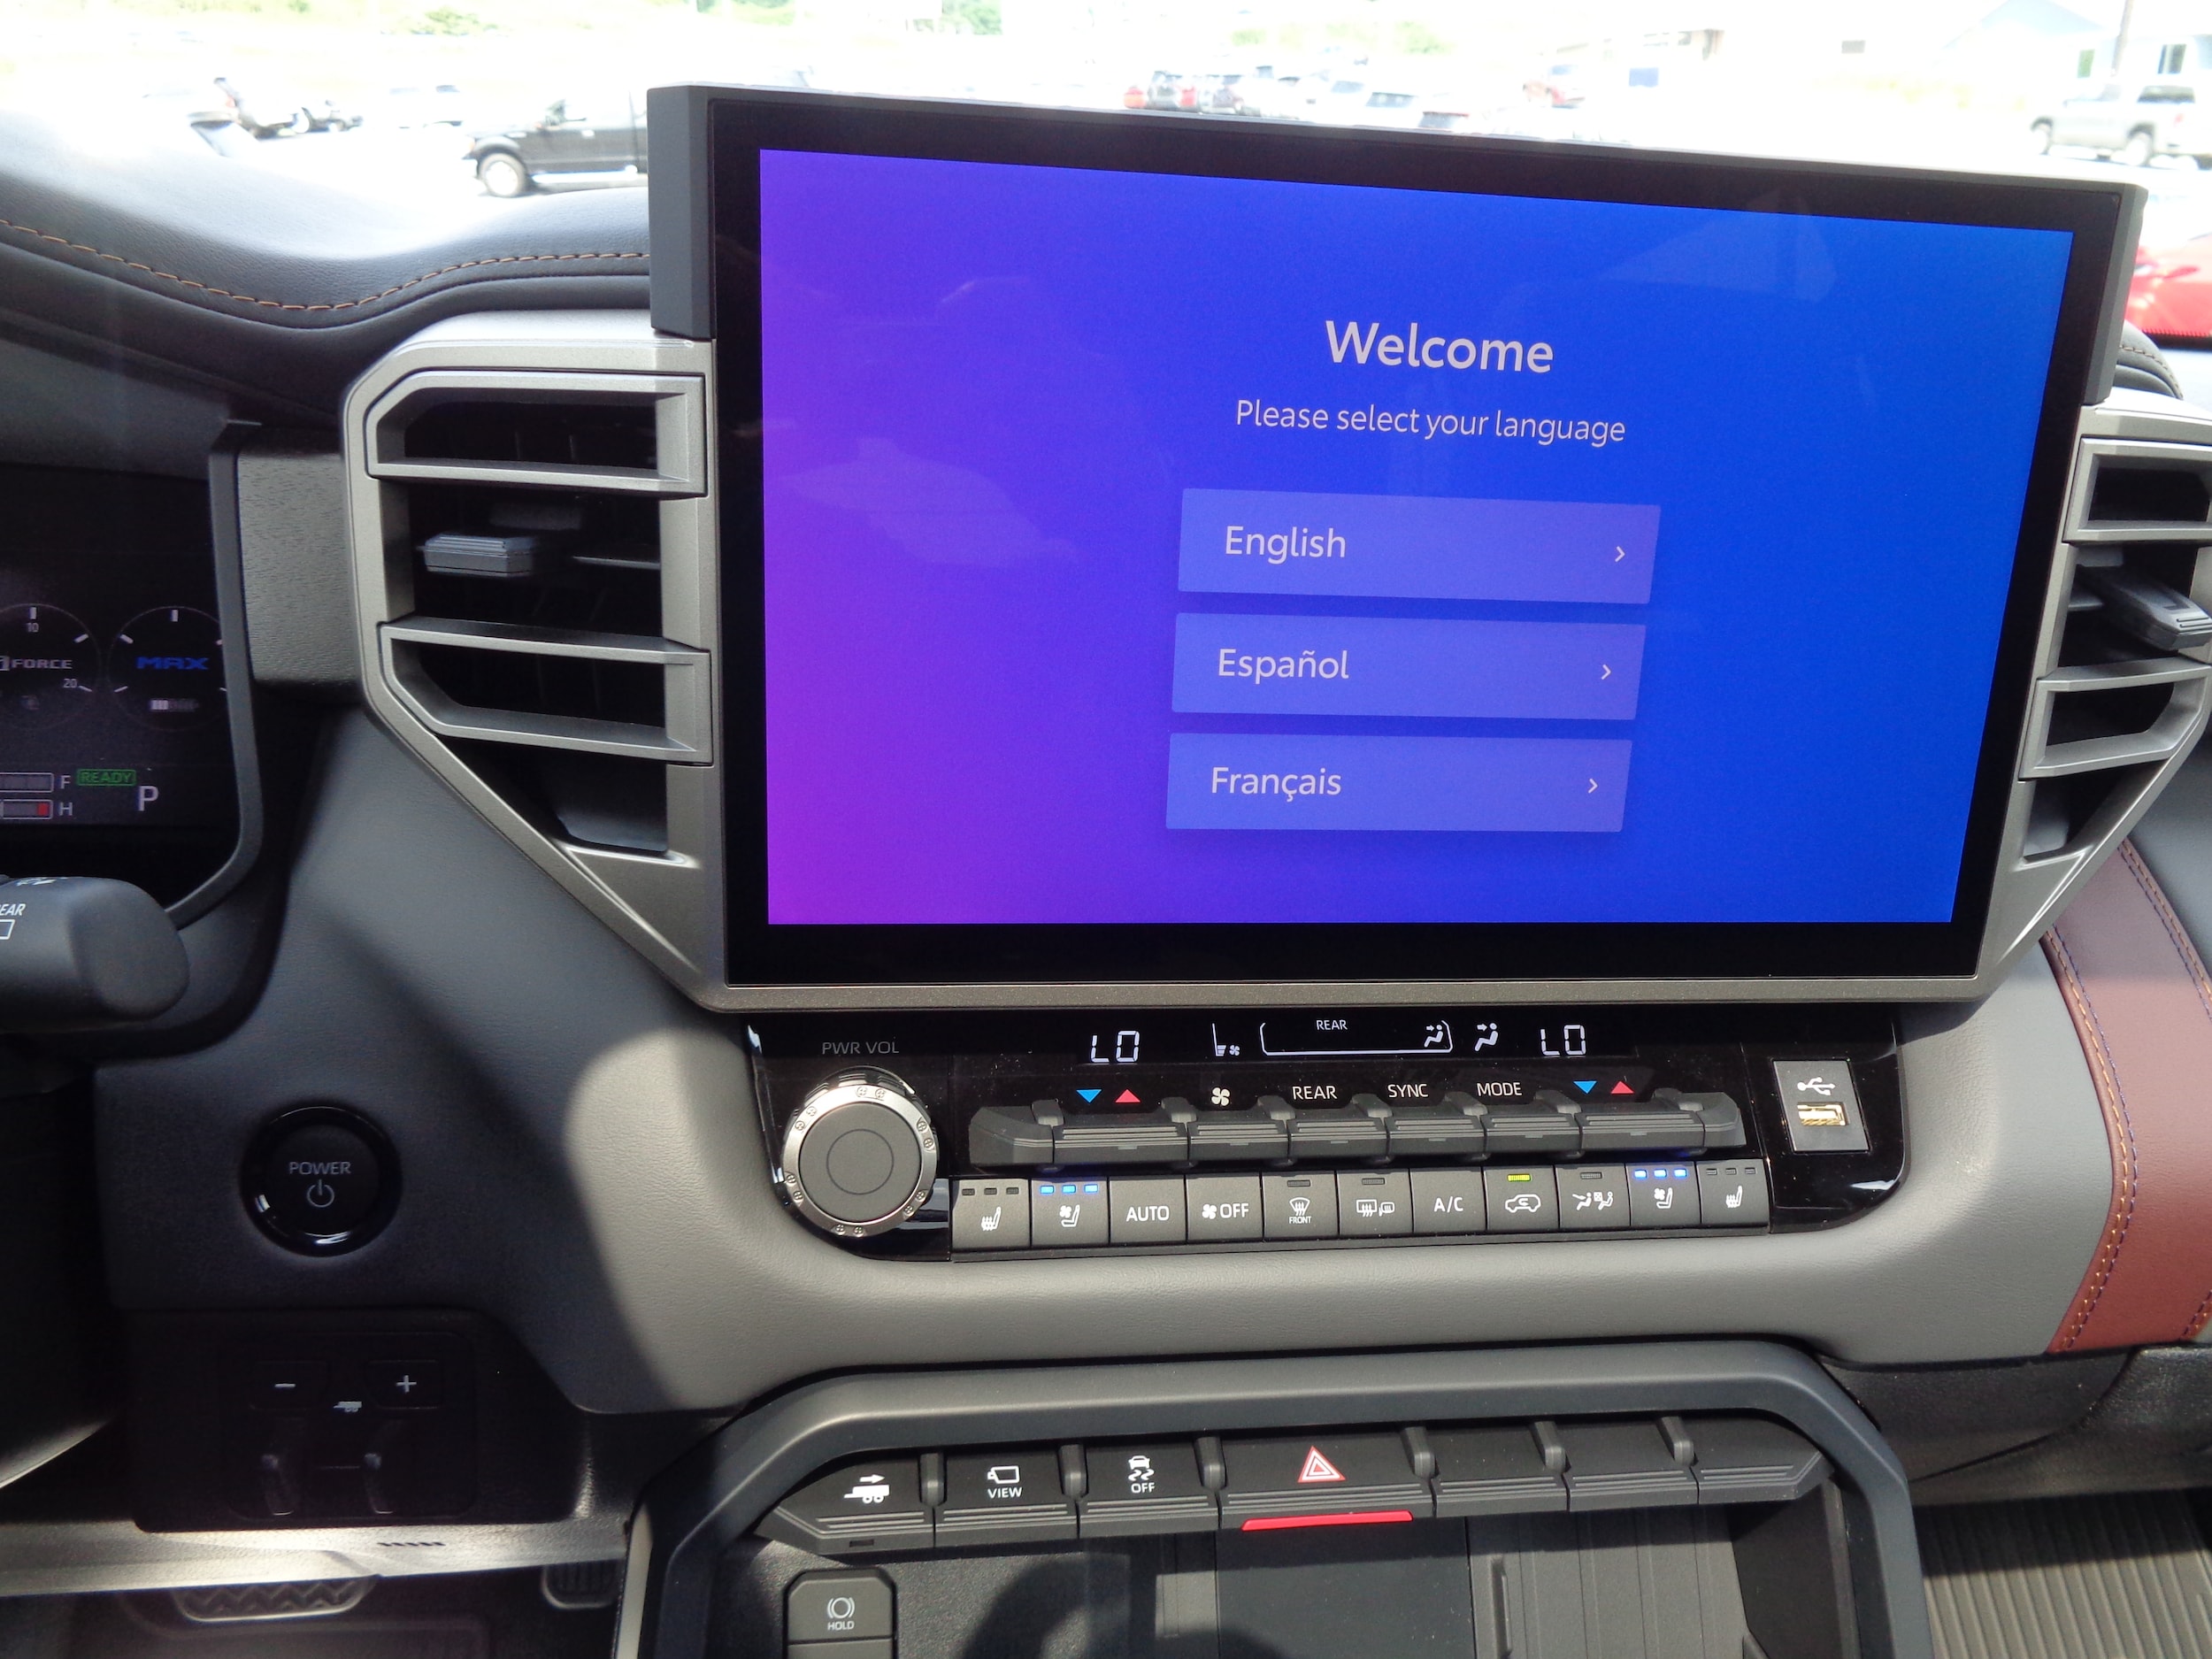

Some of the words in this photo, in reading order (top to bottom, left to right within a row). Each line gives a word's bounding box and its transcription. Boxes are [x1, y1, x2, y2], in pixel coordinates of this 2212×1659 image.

[1325, 319, 1555, 374] Welcome
[1235, 399, 1329, 429] Please
[1336, 405, 1420, 433] select
[1425, 413, 1489, 440] your
[1494, 411, 1626, 448] language
[1225, 526, 1347, 565] English
[27, 623, 39, 633] 10
[136, 657, 209, 671] MAX
[1217, 648, 1350, 685] Español
[63, 678, 77, 688] 20
[60, 775, 71, 789] F
[81, 772, 132, 784] READY
[1210, 765, 1342, 802] Français
[137, 785, 159, 812] P
[59, 803, 73, 817] H
[1316, 1019, 1348, 1031] REAR
[821, 1041, 862, 1055] PWR
[865, 1041, 900, 1055] VOL
[1292, 1086, 1338, 1101] REAR
[1387, 1083, 1429, 1099] SYNC
[1477, 1081, 1523, 1098] MODE
[288, 1161, 351, 1175] POWER
[1219, 1202, 1250, 1218] OFF
[1432, 1196, 1464, 1213] A/C
[1125, 1206, 1171, 1223] AUTO
[1288, 1216, 1312, 1225] FRONT
[987, 1486, 1023, 1499] VIEW
[1130, 1481, 1156, 1494] OFF
[827, 1621, 855, 1631] HOLD
